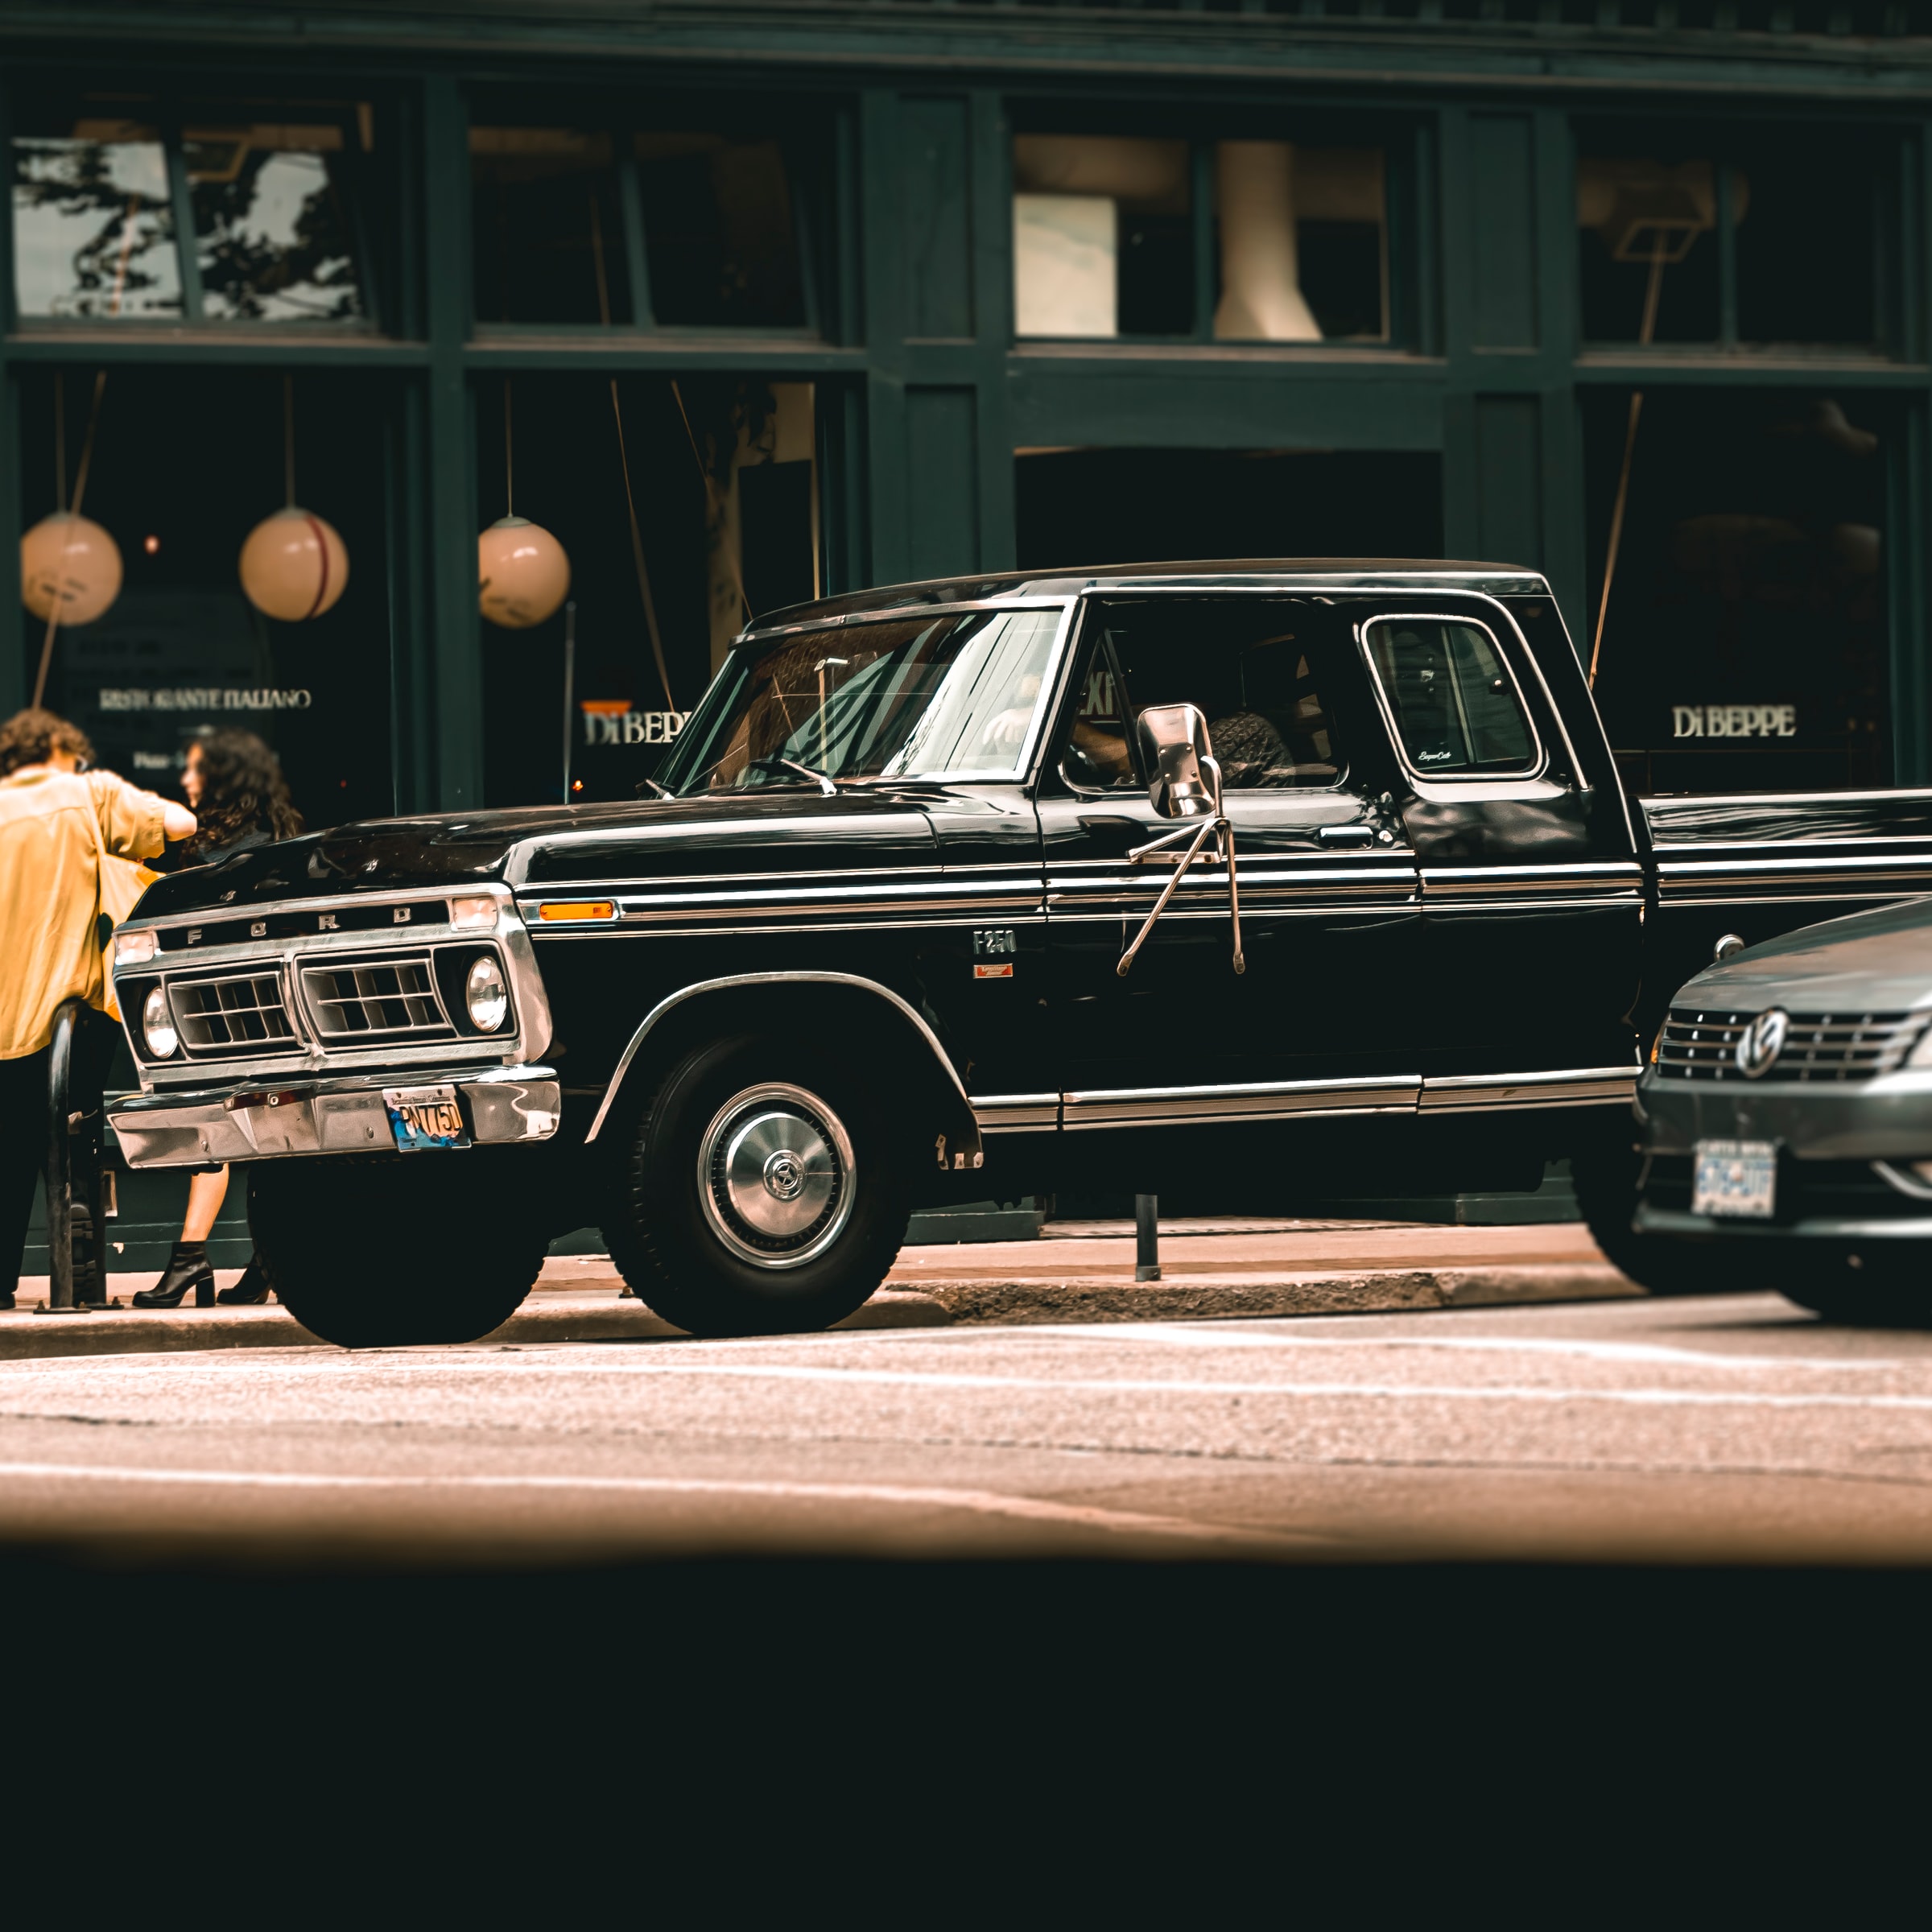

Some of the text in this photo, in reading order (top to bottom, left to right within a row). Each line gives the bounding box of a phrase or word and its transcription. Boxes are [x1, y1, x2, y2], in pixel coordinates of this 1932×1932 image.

[224, 688, 312, 709] ITALIANO
[1673, 705, 1797, 737] Di BEPPE
[187, 907, 411, 945] FORD
